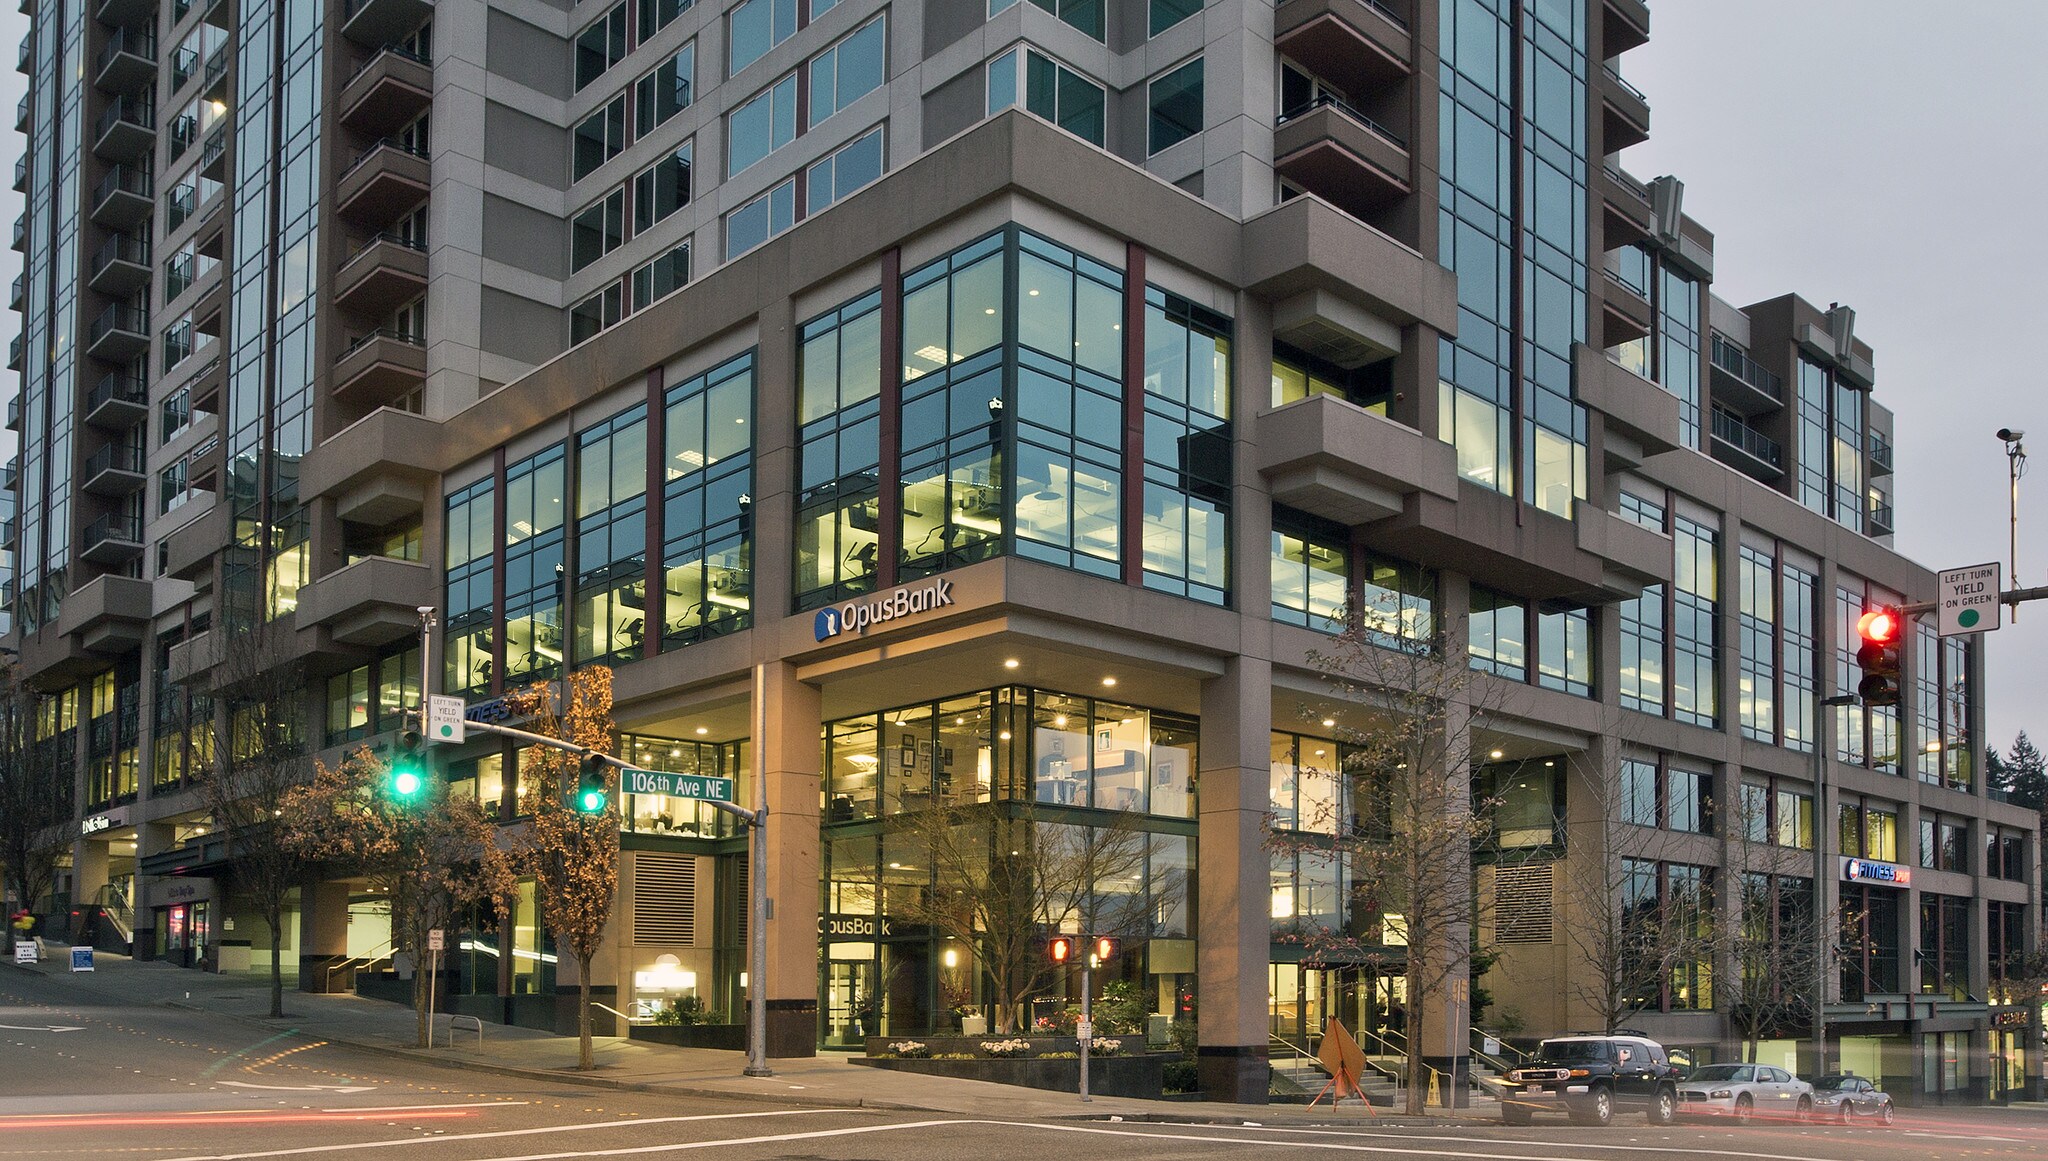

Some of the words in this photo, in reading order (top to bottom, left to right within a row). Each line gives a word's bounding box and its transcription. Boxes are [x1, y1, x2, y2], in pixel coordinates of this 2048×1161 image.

[1944, 572, 1966, 584] LEFT
[1970, 568, 1993, 580] TURN
[1953, 581, 1984, 596] YIELD
[841, 578, 952, 634] OpusBank
[1945, 599, 1958, 609] ON
[1961, 594, 1992, 606] GREEN
[433, 698, 447, 706] LEFT
[438, 707, 457, 716] YIELD
[466, 700, 509, 722] NESS
[442, 716, 460, 724] GREEN
[631, 772, 670, 793] 106th
[675, 777, 700, 797] Ave
[705, 779, 724, 799] NE
[1858, 861, 1895, 881] FITNESS
[817, 916, 891, 936] OpusBak
